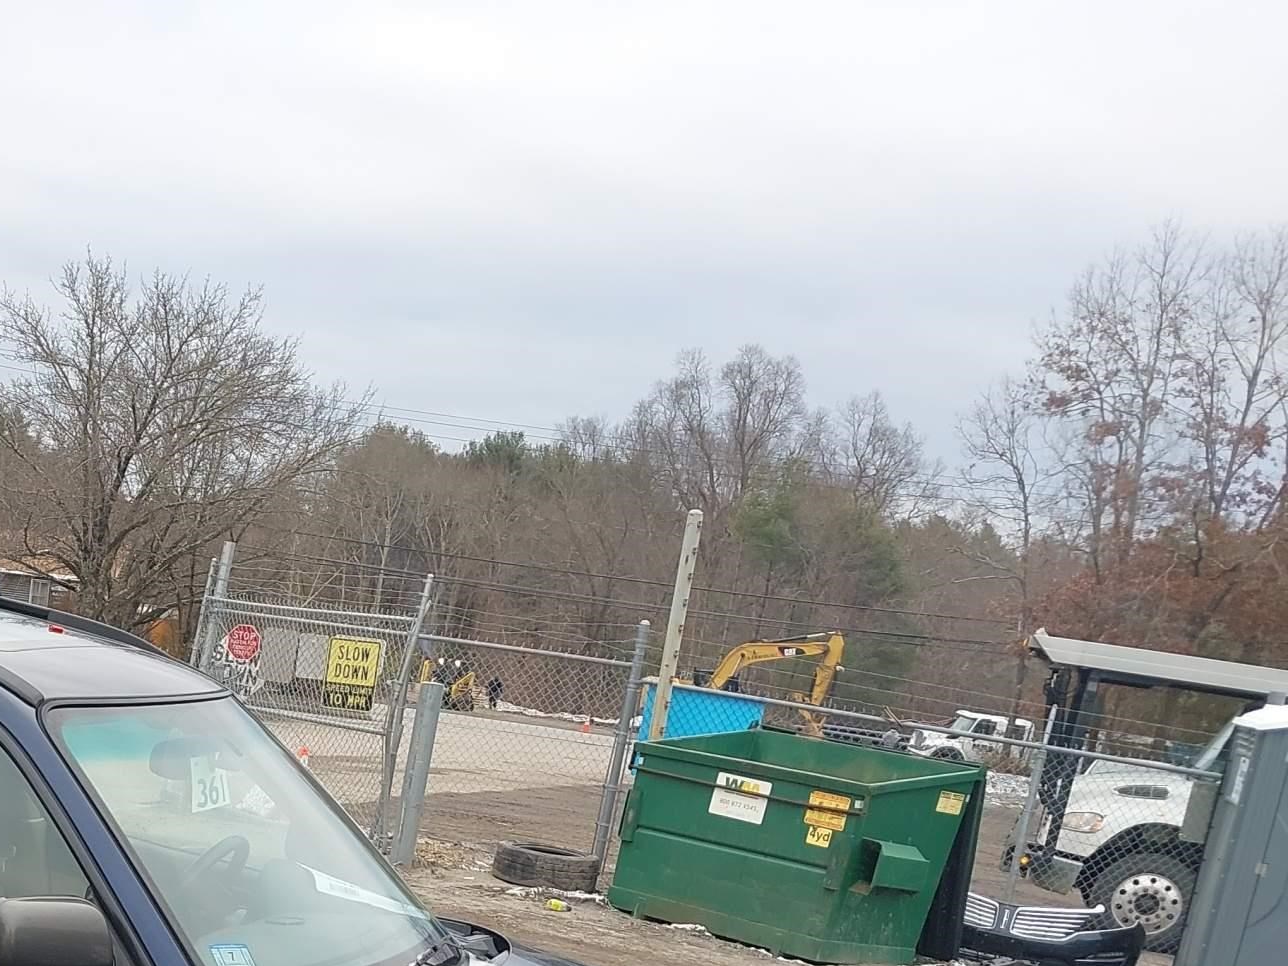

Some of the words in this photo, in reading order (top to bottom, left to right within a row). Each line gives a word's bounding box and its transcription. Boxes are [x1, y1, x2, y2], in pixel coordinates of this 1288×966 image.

[232, 630, 257, 640] STOP
[337, 645, 372, 661] SLOW
[334, 663, 369, 681] DOWN
[326, 683, 350, 693] SPEED
[329, 693, 343, 706] 10
[347, 695, 366, 709] MPH
[197, 774, 226, 808] 361
